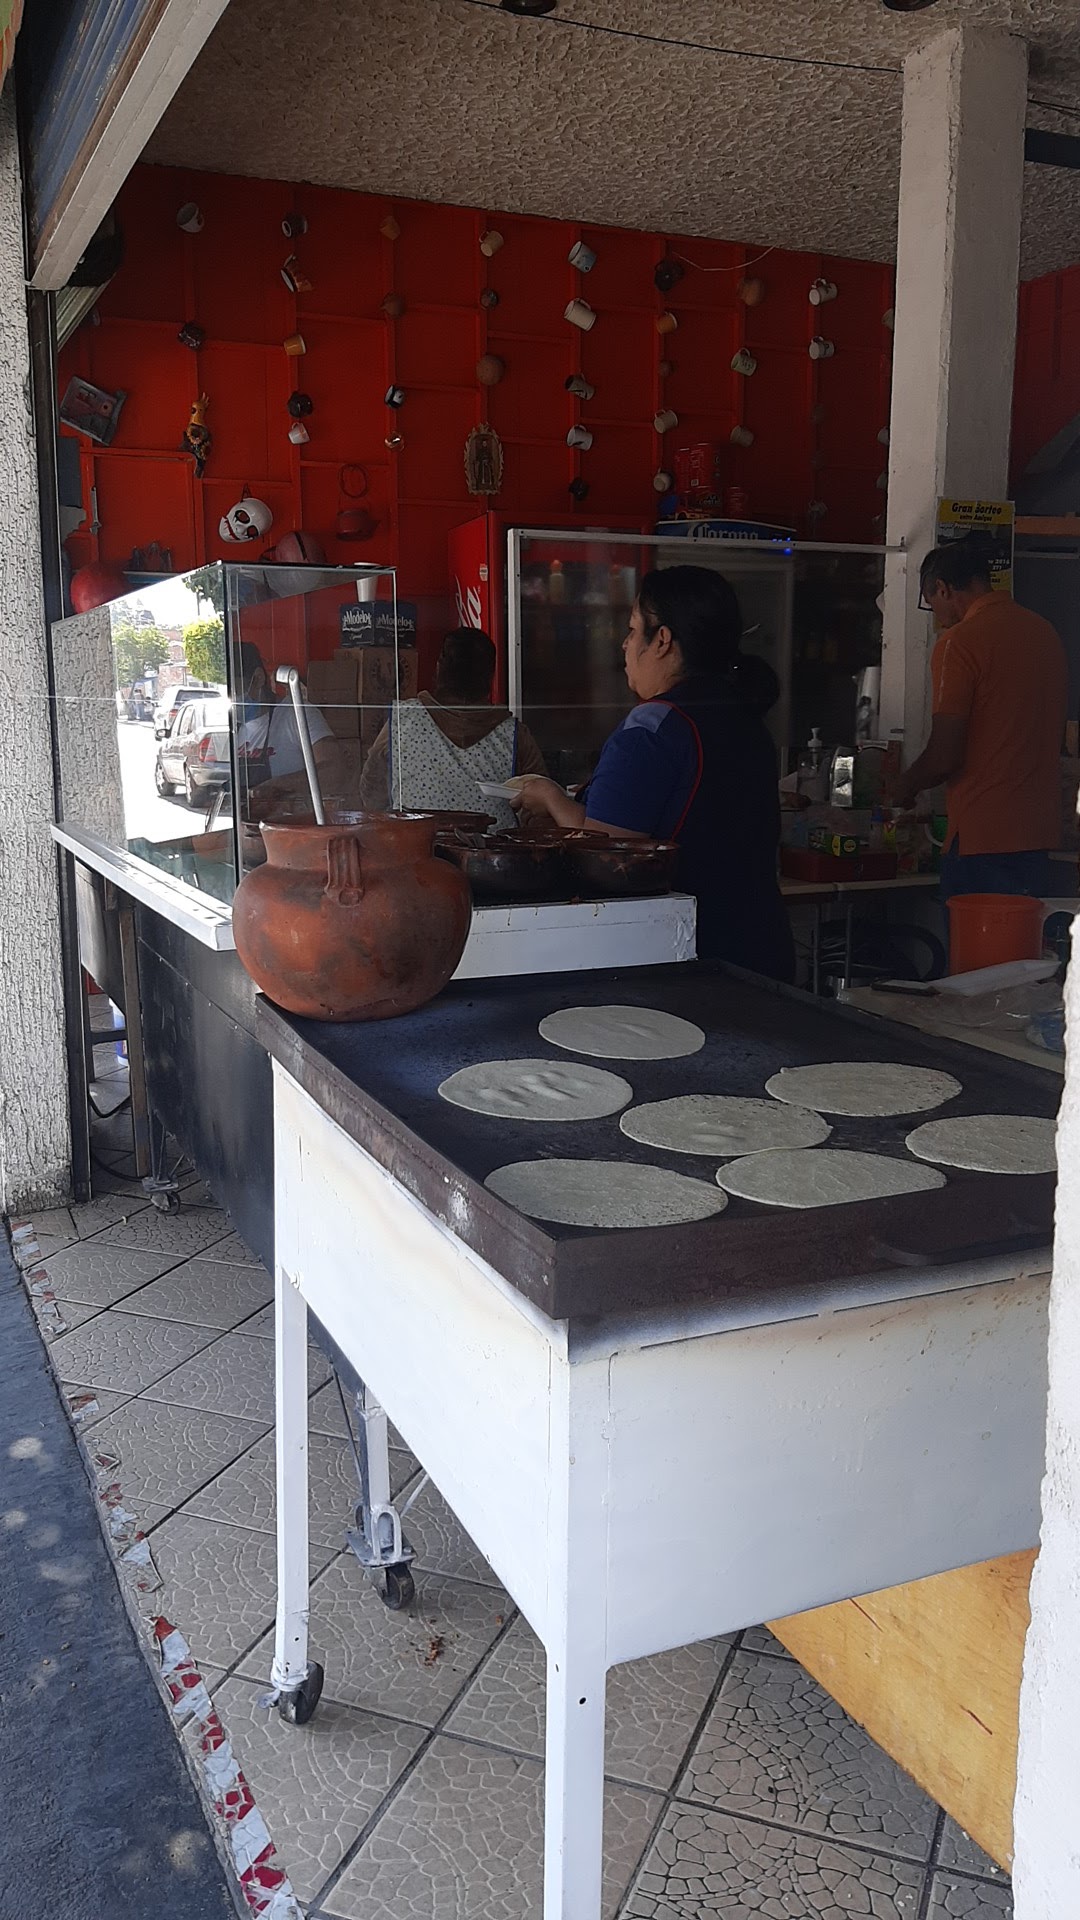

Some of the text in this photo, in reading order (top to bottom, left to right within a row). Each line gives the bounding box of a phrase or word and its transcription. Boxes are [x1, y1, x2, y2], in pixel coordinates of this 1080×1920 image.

[952, 502, 1002, 514] Gran Sorteo
[687, 522, 759, 540] Corona
[344, 610, 370, 625] Modelo
